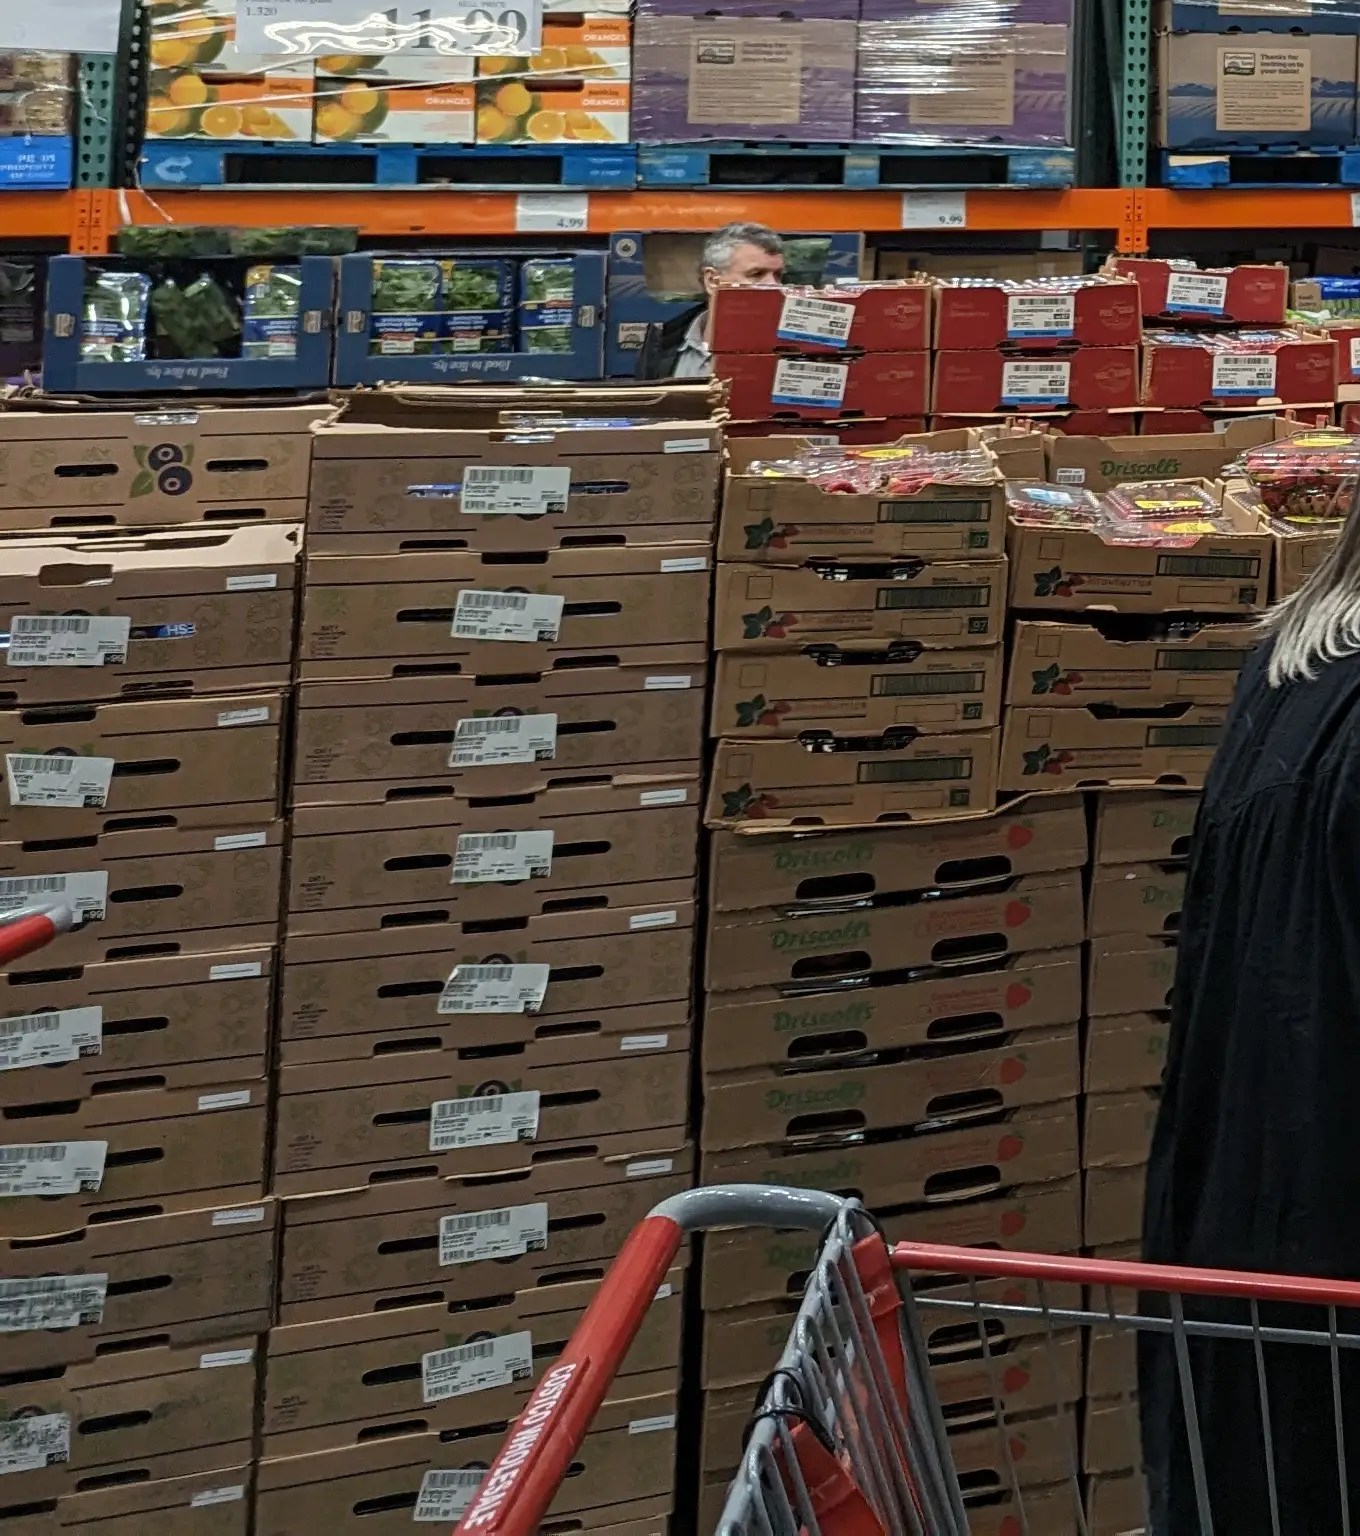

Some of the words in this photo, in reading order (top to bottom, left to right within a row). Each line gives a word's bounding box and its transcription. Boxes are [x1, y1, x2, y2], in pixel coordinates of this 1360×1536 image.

[583, 97, 626, 107] ORANGES
[556, 217, 584, 229] 4.99
[939, 215, 963, 226] 9.99
[1101, 457, 1180, 478] Driscoll's
[775, 843, 874, 871] Driscoll's
[771, 920, 871, 949] Driscoll's
[773, 1002, 874, 1031] Driscoll's
[523, 1363, 577, 1425] COSTCO
[464, 1422, 545, 1529] WHOLESALE
